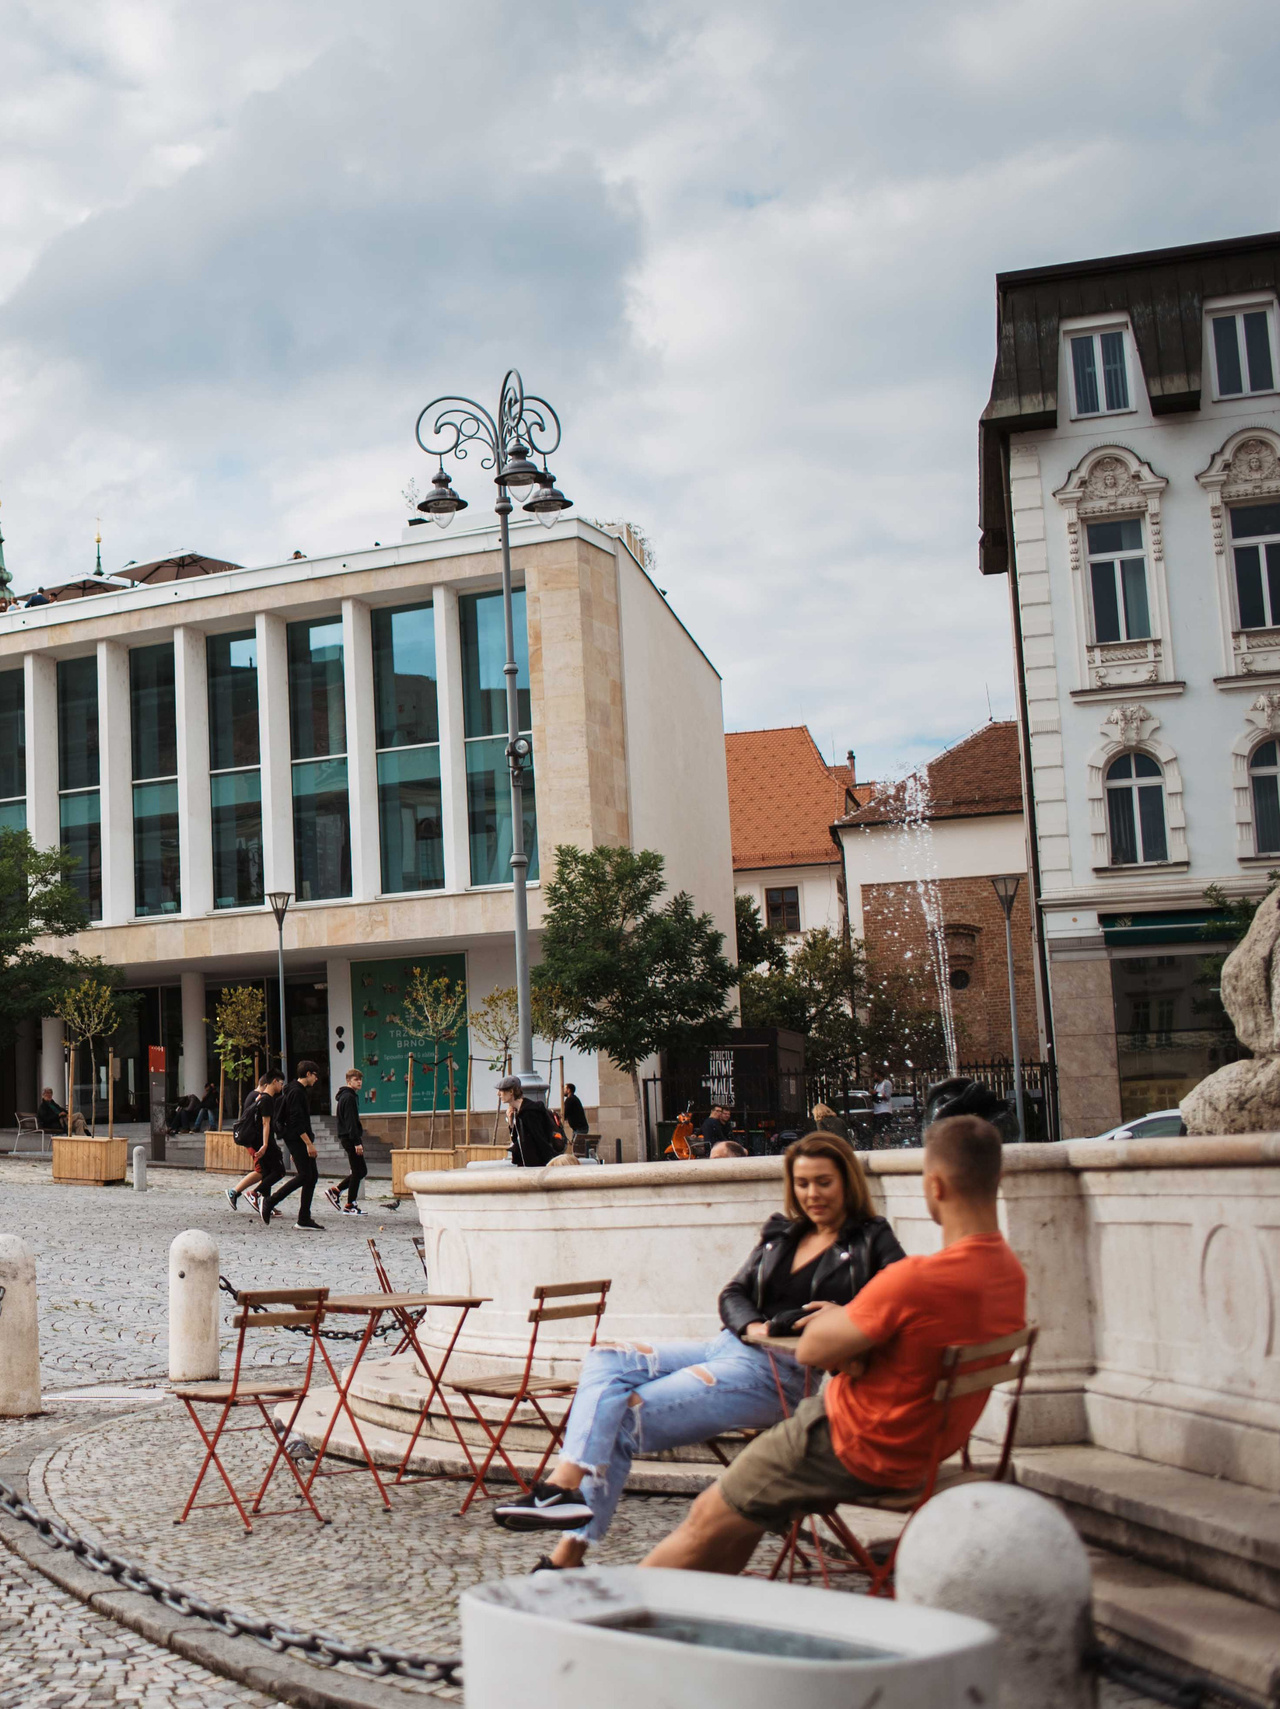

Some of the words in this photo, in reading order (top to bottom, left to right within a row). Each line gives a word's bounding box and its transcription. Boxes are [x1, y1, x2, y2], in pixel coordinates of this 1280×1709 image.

[397, 1039, 426, 1048] BRNO
[709, 1050, 734, 1060] STRICTLY
[710, 1060, 734, 1077] HOME
[710, 1078, 735, 1094] MADE
